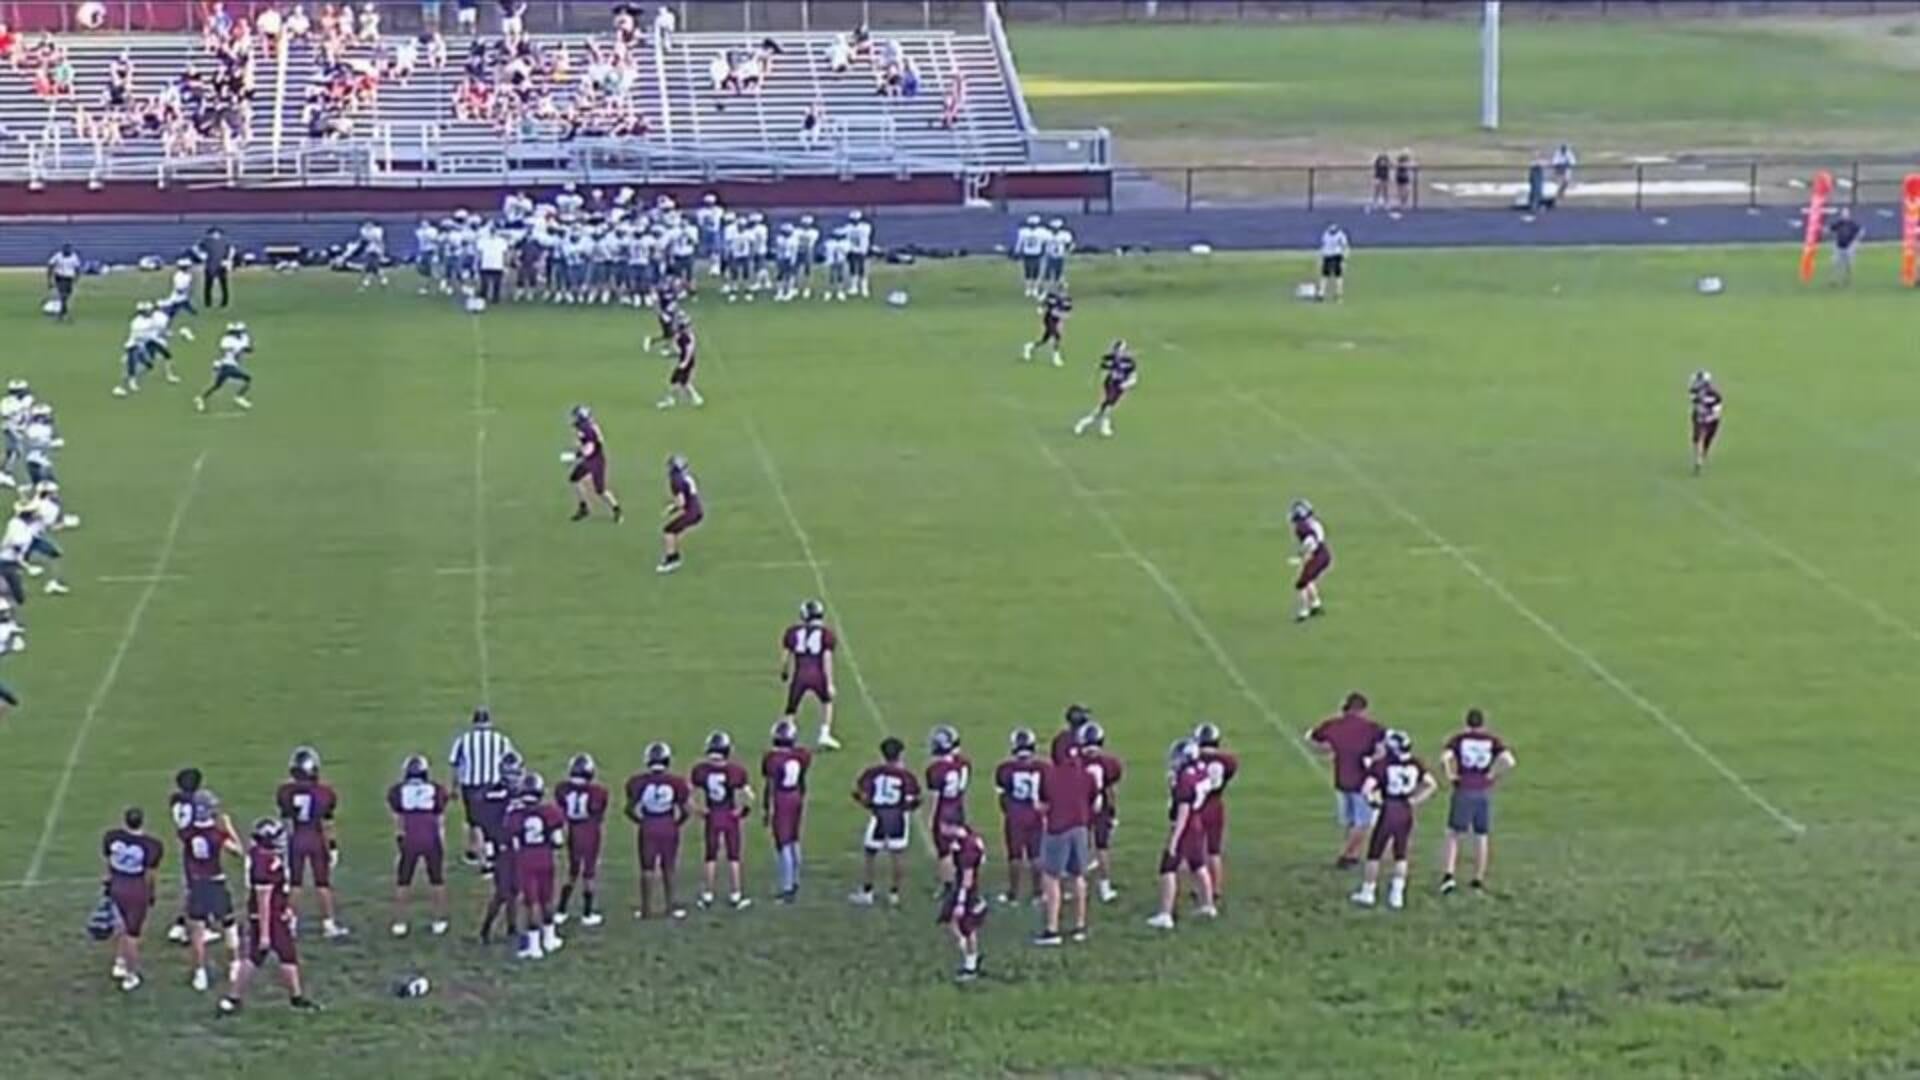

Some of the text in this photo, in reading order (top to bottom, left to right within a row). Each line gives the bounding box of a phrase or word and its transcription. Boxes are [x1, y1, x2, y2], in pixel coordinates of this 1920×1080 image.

[795, 627, 822, 655] 14
[706, 772, 727, 801] 5
[873, 773, 902, 805] 15
[293, 794, 312, 821] 7
[523, 816, 545, 844] 2
